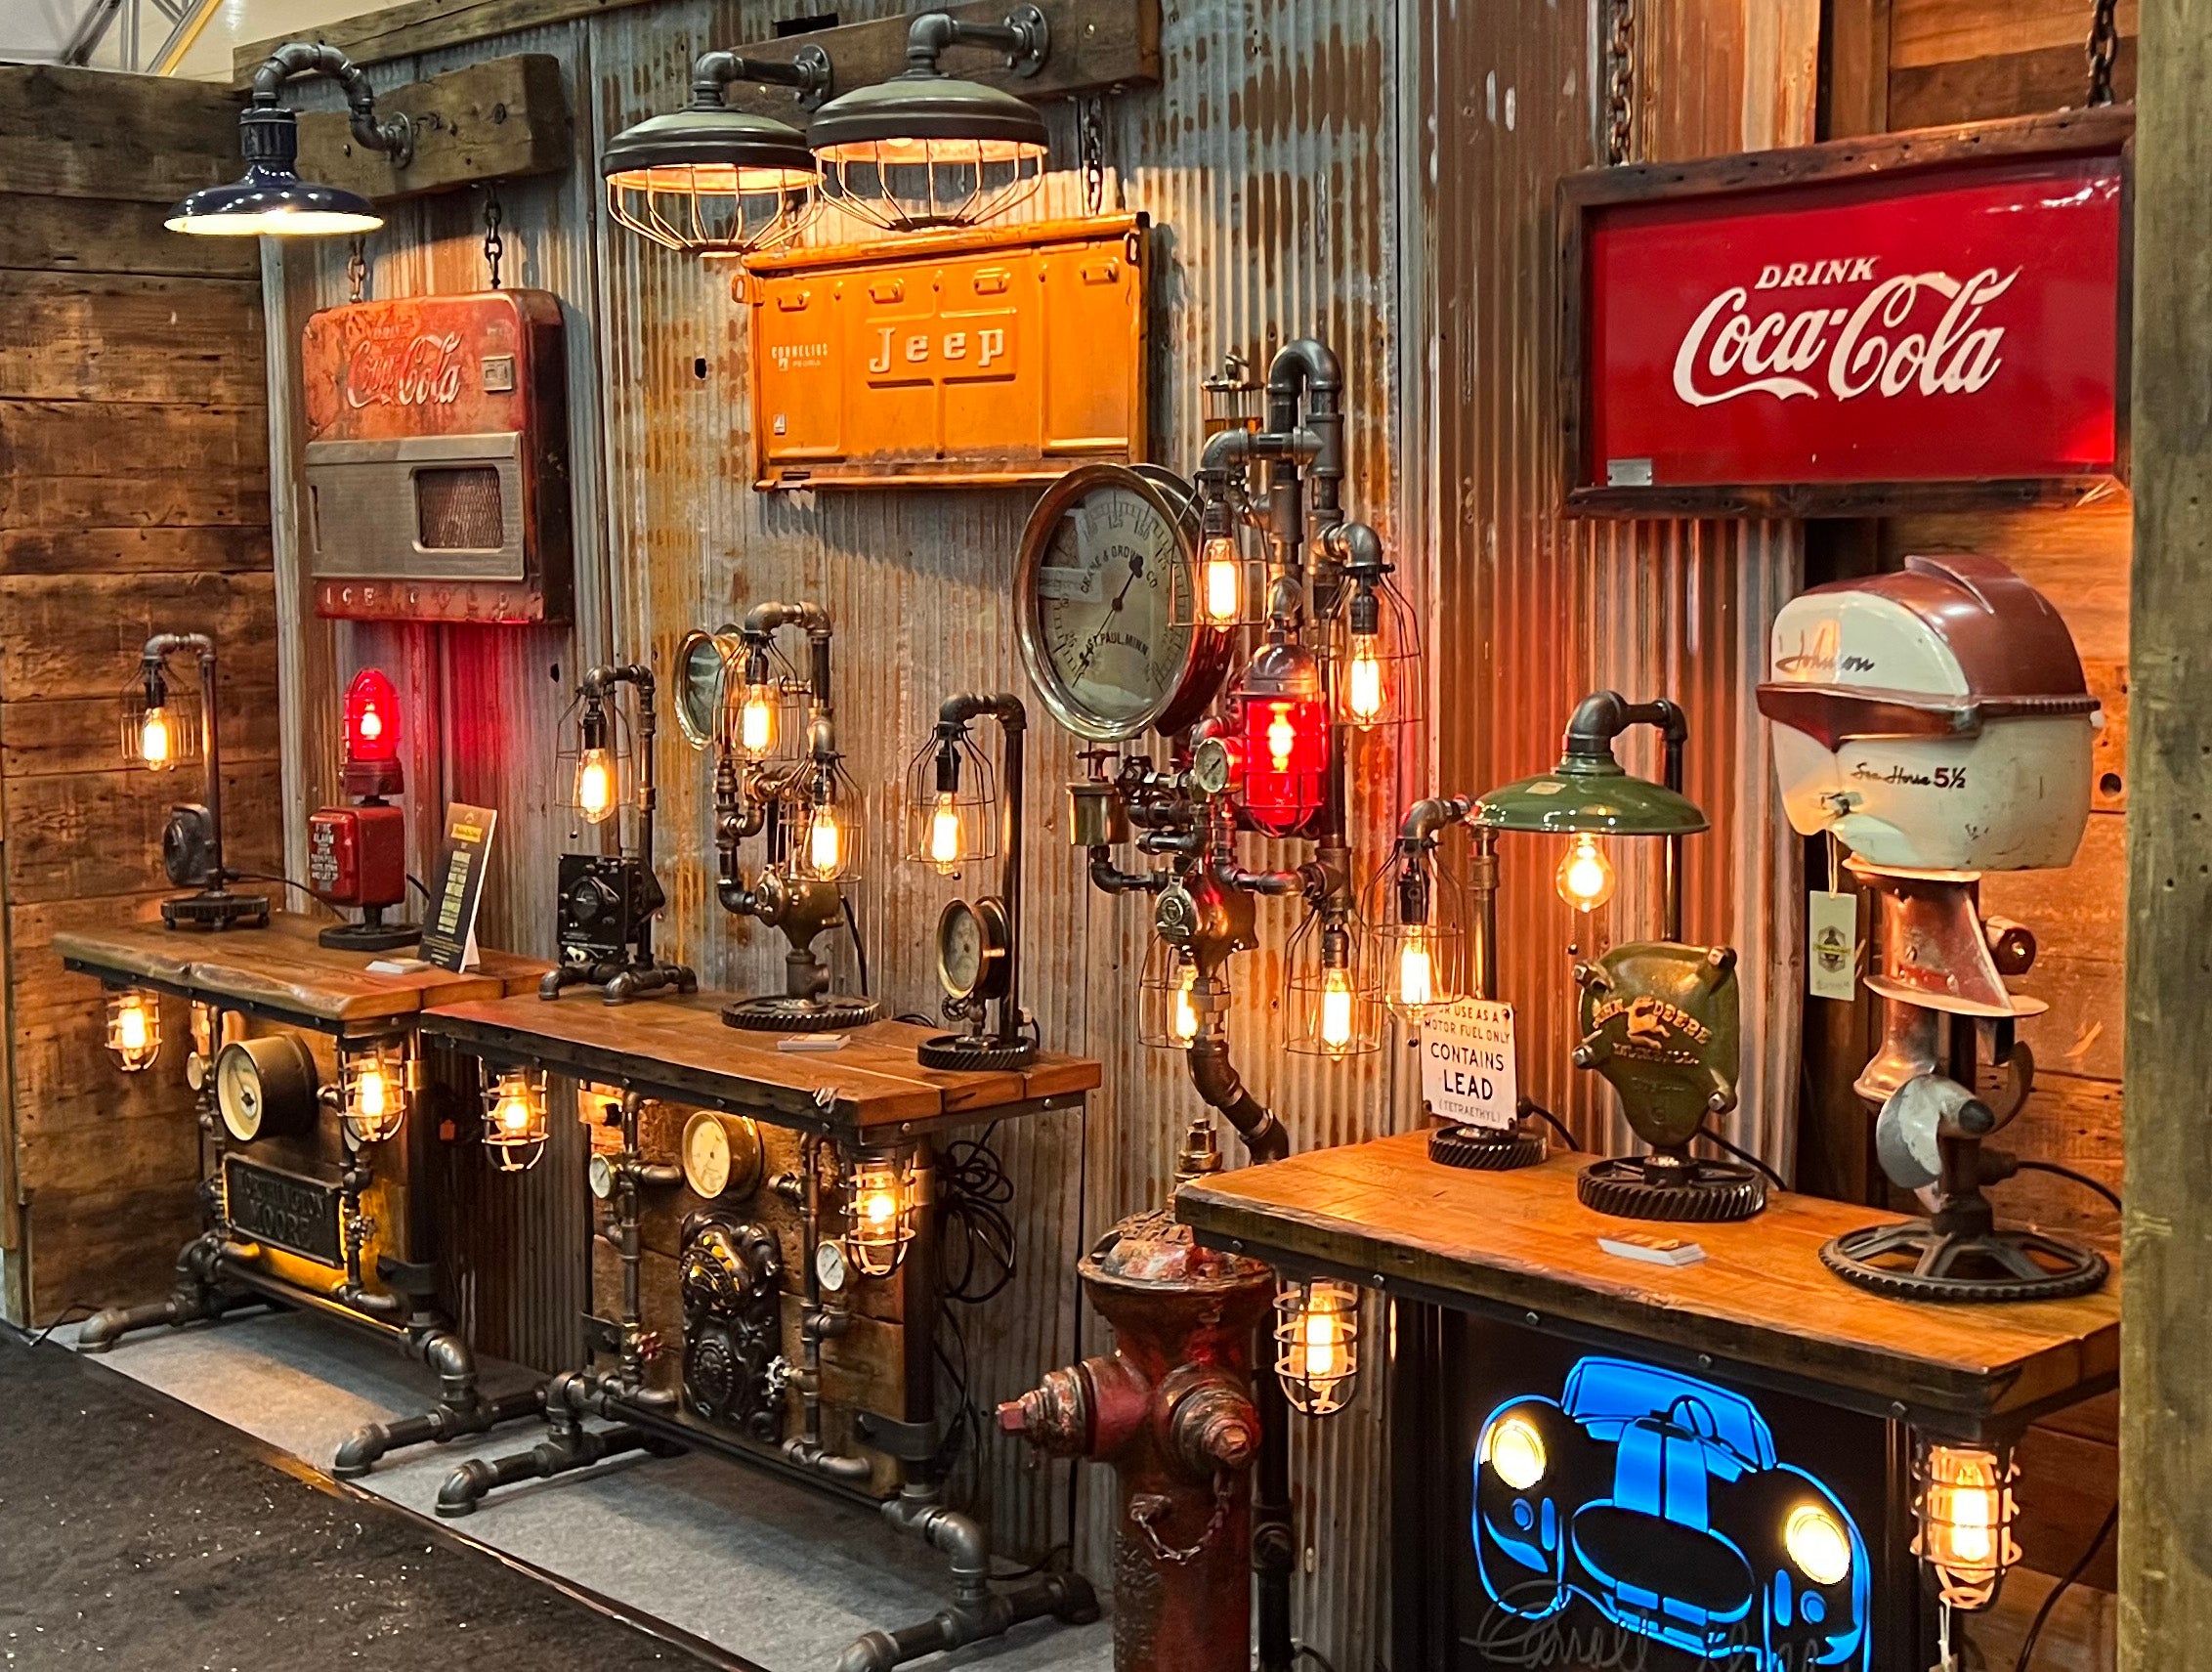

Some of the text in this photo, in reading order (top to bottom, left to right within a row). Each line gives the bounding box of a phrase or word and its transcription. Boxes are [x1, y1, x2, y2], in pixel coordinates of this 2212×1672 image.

[1755, 255, 1881, 290] DRINK
[771, 342, 828, 360] CORNELIUS
[868, 326, 1004, 374] Jeep
[1673, 265, 2023, 407] Coca-Cola
[1080, 555, 1101, 594] CRANE
[325, 586, 375, 607] ICE
[1775, 627, 1876, 674] Johnson
[1454, 1005, 1473, 1019] USE
[1476, 1008, 1489, 1021] AS
[1492, 1011, 1500, 1023] A
[1424, 1018, 1510, 1045] MOTOR FUEL ONLY
[1430, 1042, 1505, 1072] CONTAINS
[1443, 1069, 1494, 1100] LEAD
[1439, 1097, 1502, 1123] (TETRAETHYL)
